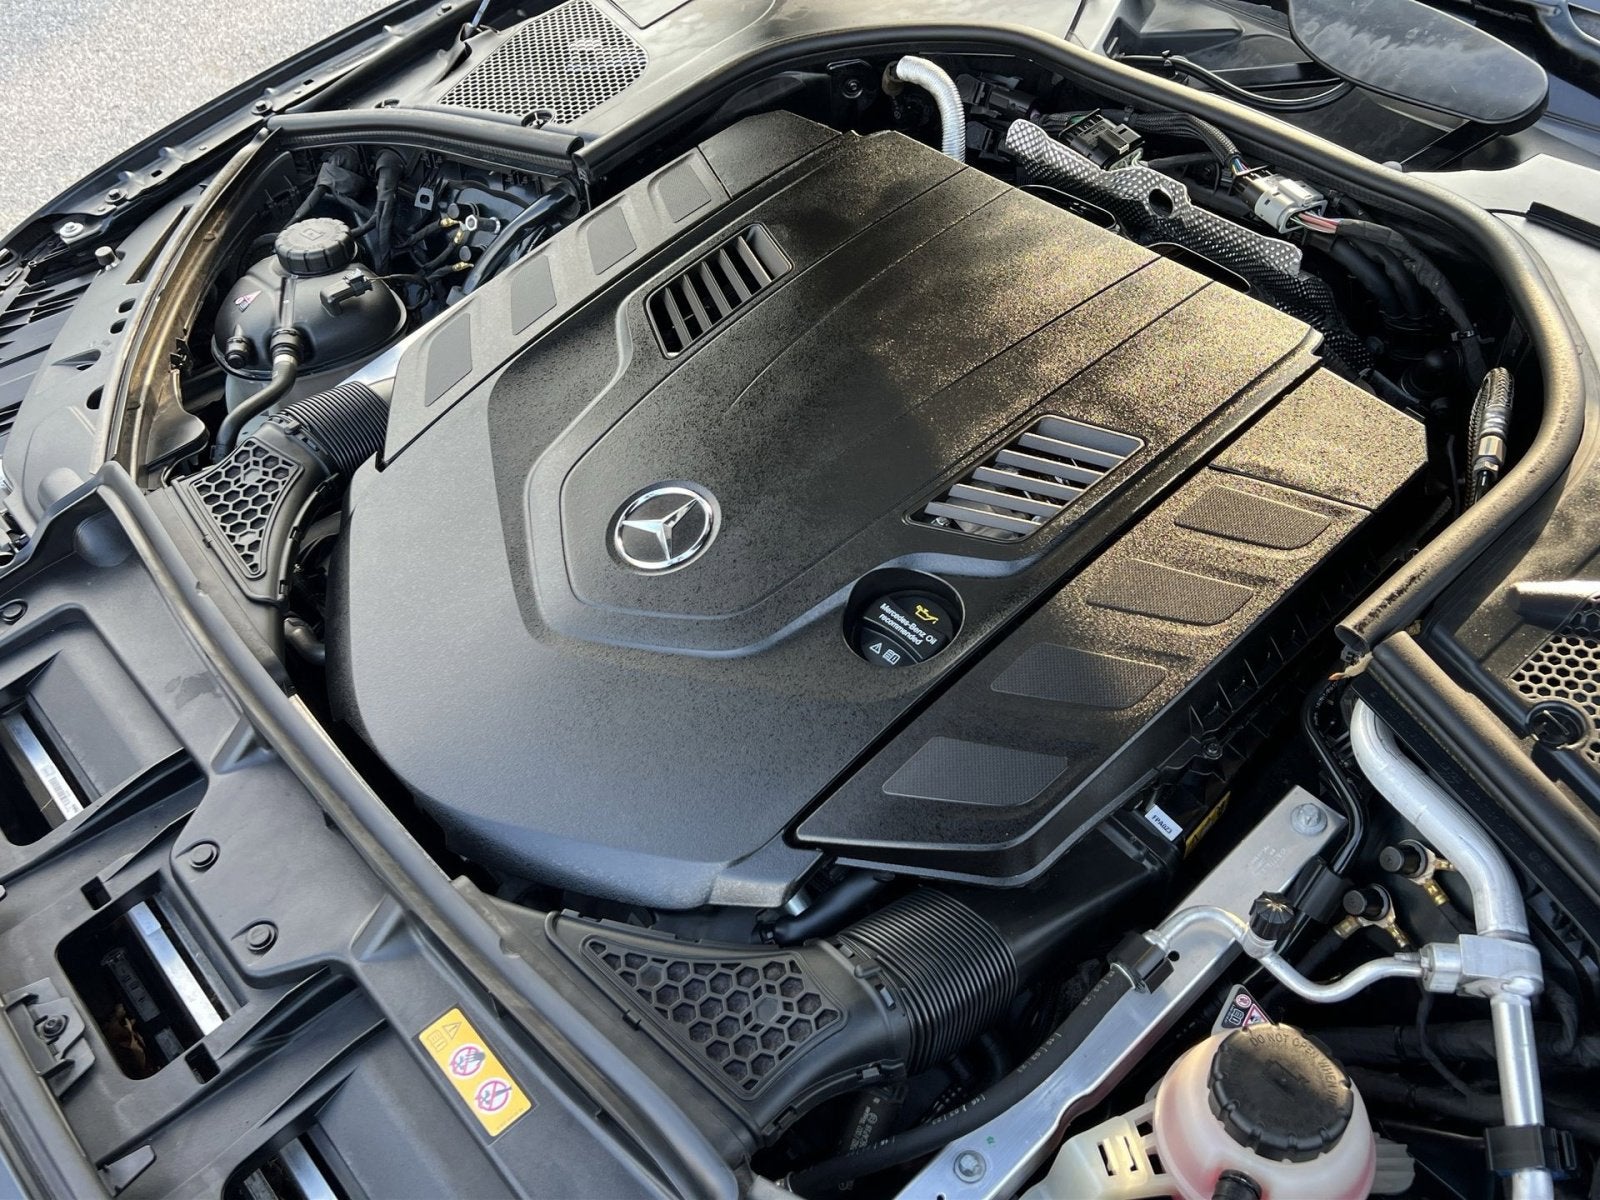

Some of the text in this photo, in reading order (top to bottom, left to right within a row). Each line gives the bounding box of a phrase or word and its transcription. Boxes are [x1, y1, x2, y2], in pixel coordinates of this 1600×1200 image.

[879, 613, 923, 646] recommended
[880, 602, 938, 645] Mercedes-Benz Oil
[1249, 1034, 1266, 1047] DO
[1268, 1032, 1289, 1044] NOT
